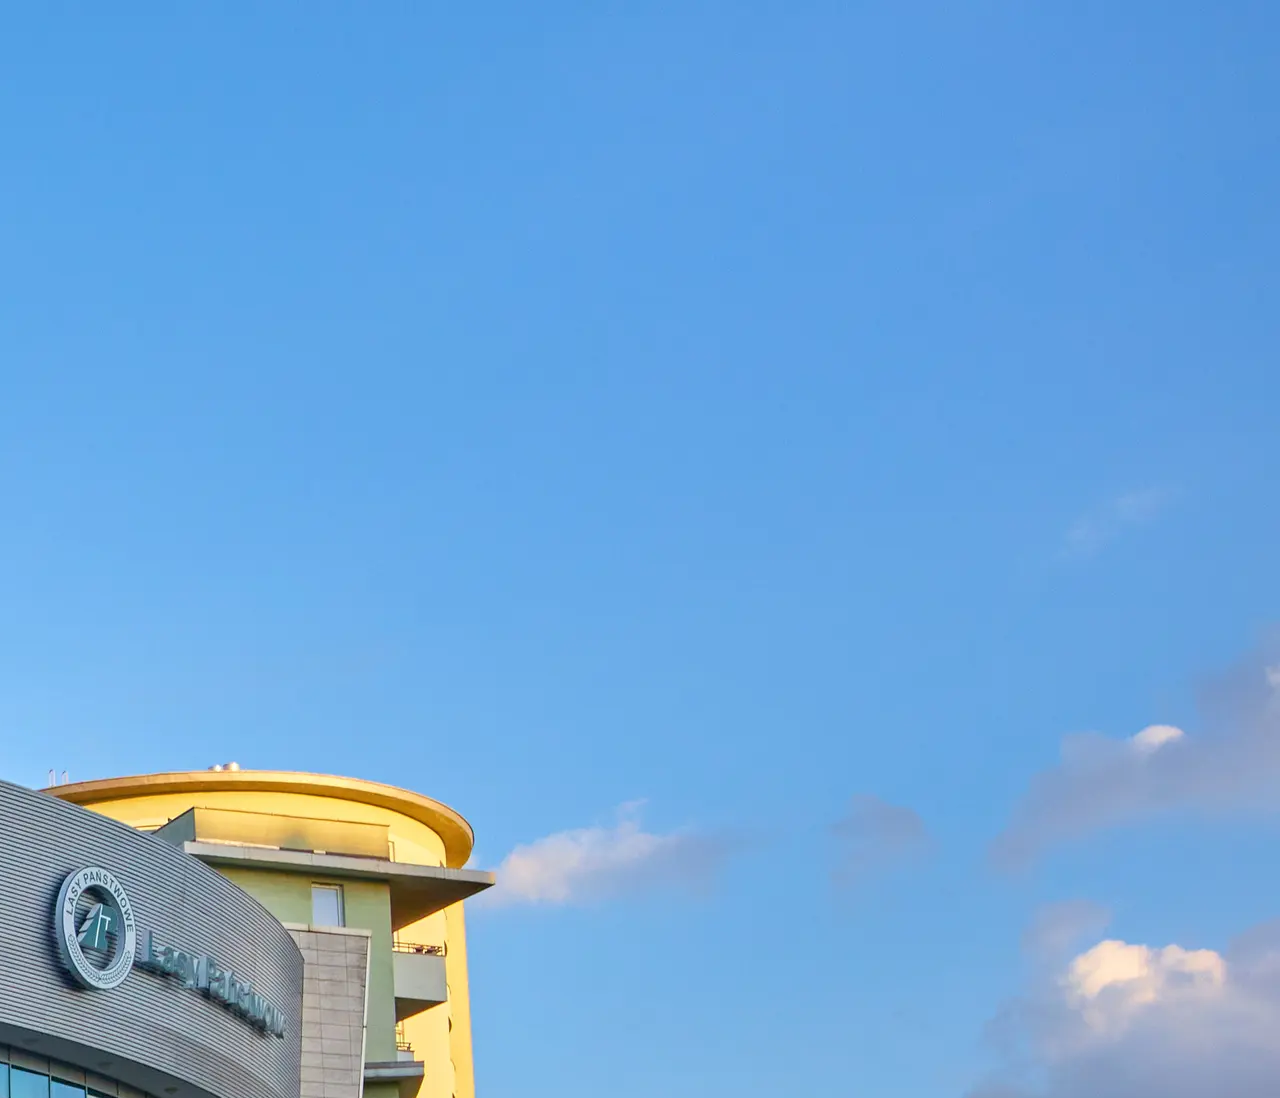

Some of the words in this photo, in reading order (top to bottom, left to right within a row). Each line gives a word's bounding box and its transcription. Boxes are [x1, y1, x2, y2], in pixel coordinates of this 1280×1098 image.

[66, 879, 82, 916] LASY
[83, 870, 134, 933] PAŃSTWOWE
[140, 930, 199, 988] Lasy
[198, 955, 288, 1038] Państwow
